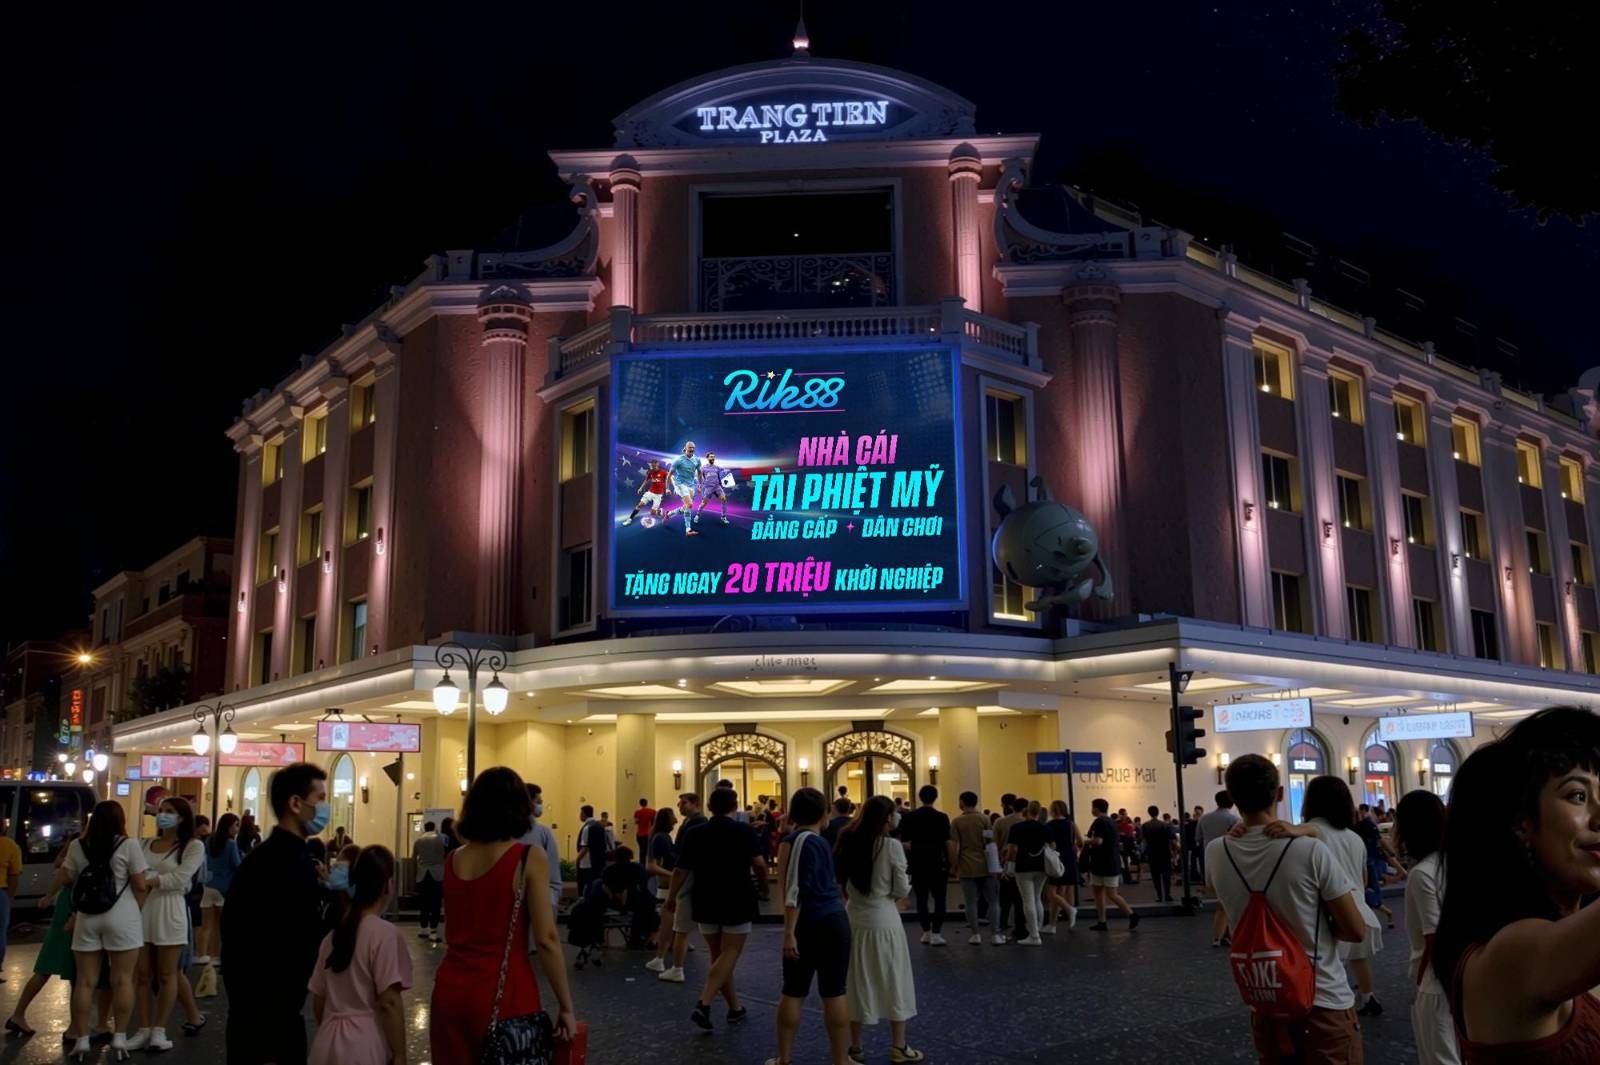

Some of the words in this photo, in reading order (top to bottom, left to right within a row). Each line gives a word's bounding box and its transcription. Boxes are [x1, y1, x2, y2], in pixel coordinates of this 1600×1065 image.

[696, 103, 808, 131] TRANG
[811, 100, 890, 126] TIEN
[759, 128, 828, 144] PLAZA
[723, 368, 846, 411] Rik88
[797, 430, 850, 467] NHÀ
[855, 428, 899, 466] CÁI
[750, 467, 798, 512] TÀI
[801, 465, 887, 516] PHIỆT
[890, 463, 945, 508] MỸ
[802, 514, 839, 540] CẤP
[861, 516, 900, 538] DÂN
[902, 515, 944, 537] CHƠI
[624, 570, 671, 600] TẶNG
[672, 571, 723, 595] NGAY
[724, 562, 760, 594] 20
[764, 556, 832, 598] TRIỆU
[879, 563, 944, 593] NGHIỆP
